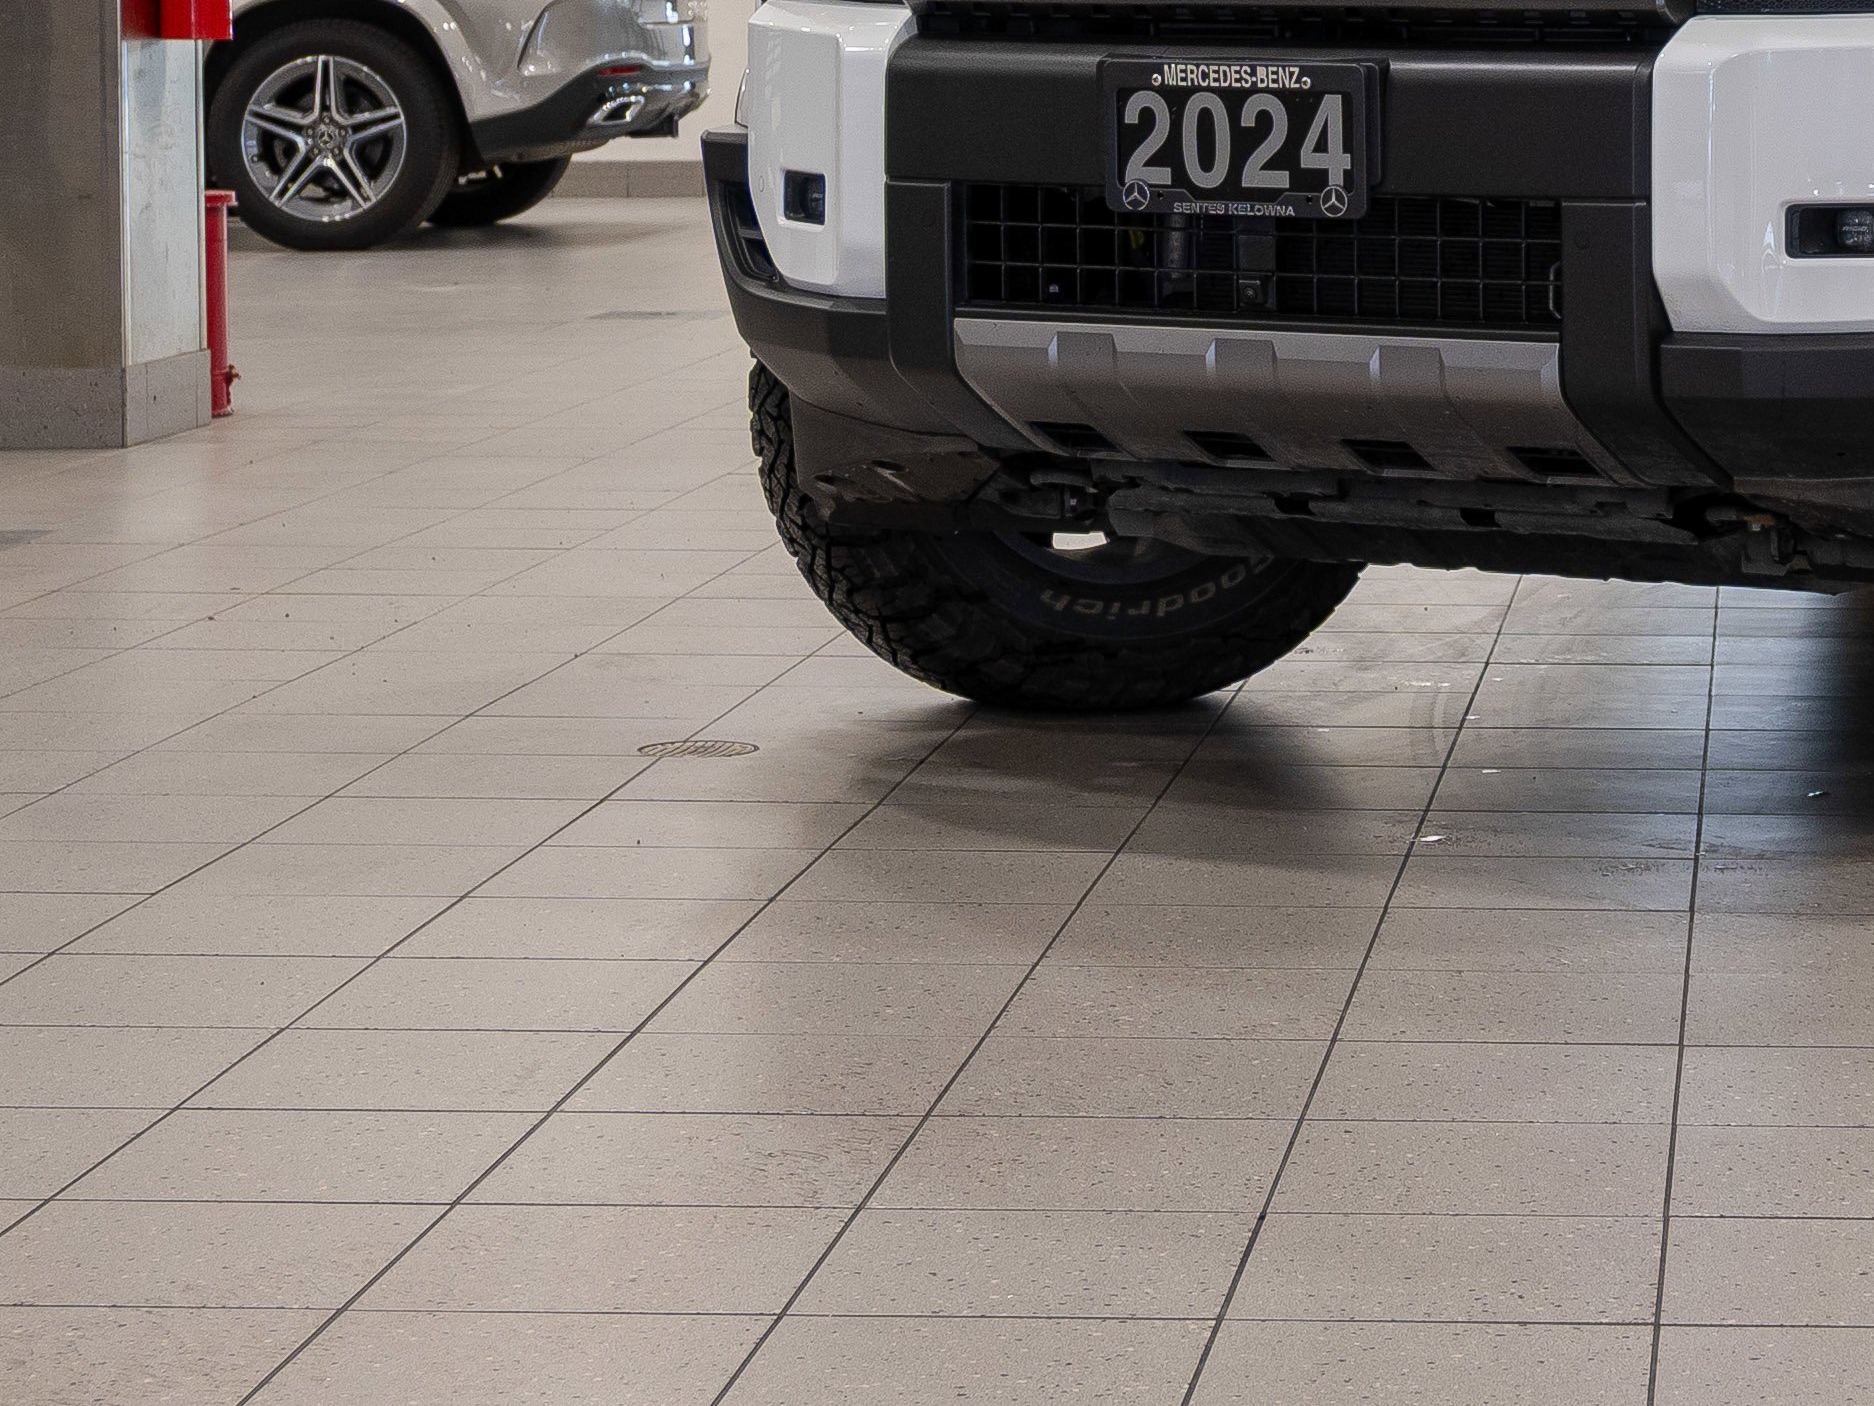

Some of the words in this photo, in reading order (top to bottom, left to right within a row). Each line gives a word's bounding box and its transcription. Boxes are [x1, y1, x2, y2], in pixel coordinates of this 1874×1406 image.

[1163, 64, 1301, 88] MERCEDES-BENZ
[1124, 90, 1351, 189] 2024
[1228, 203, 1296, 217] KELOWNA
